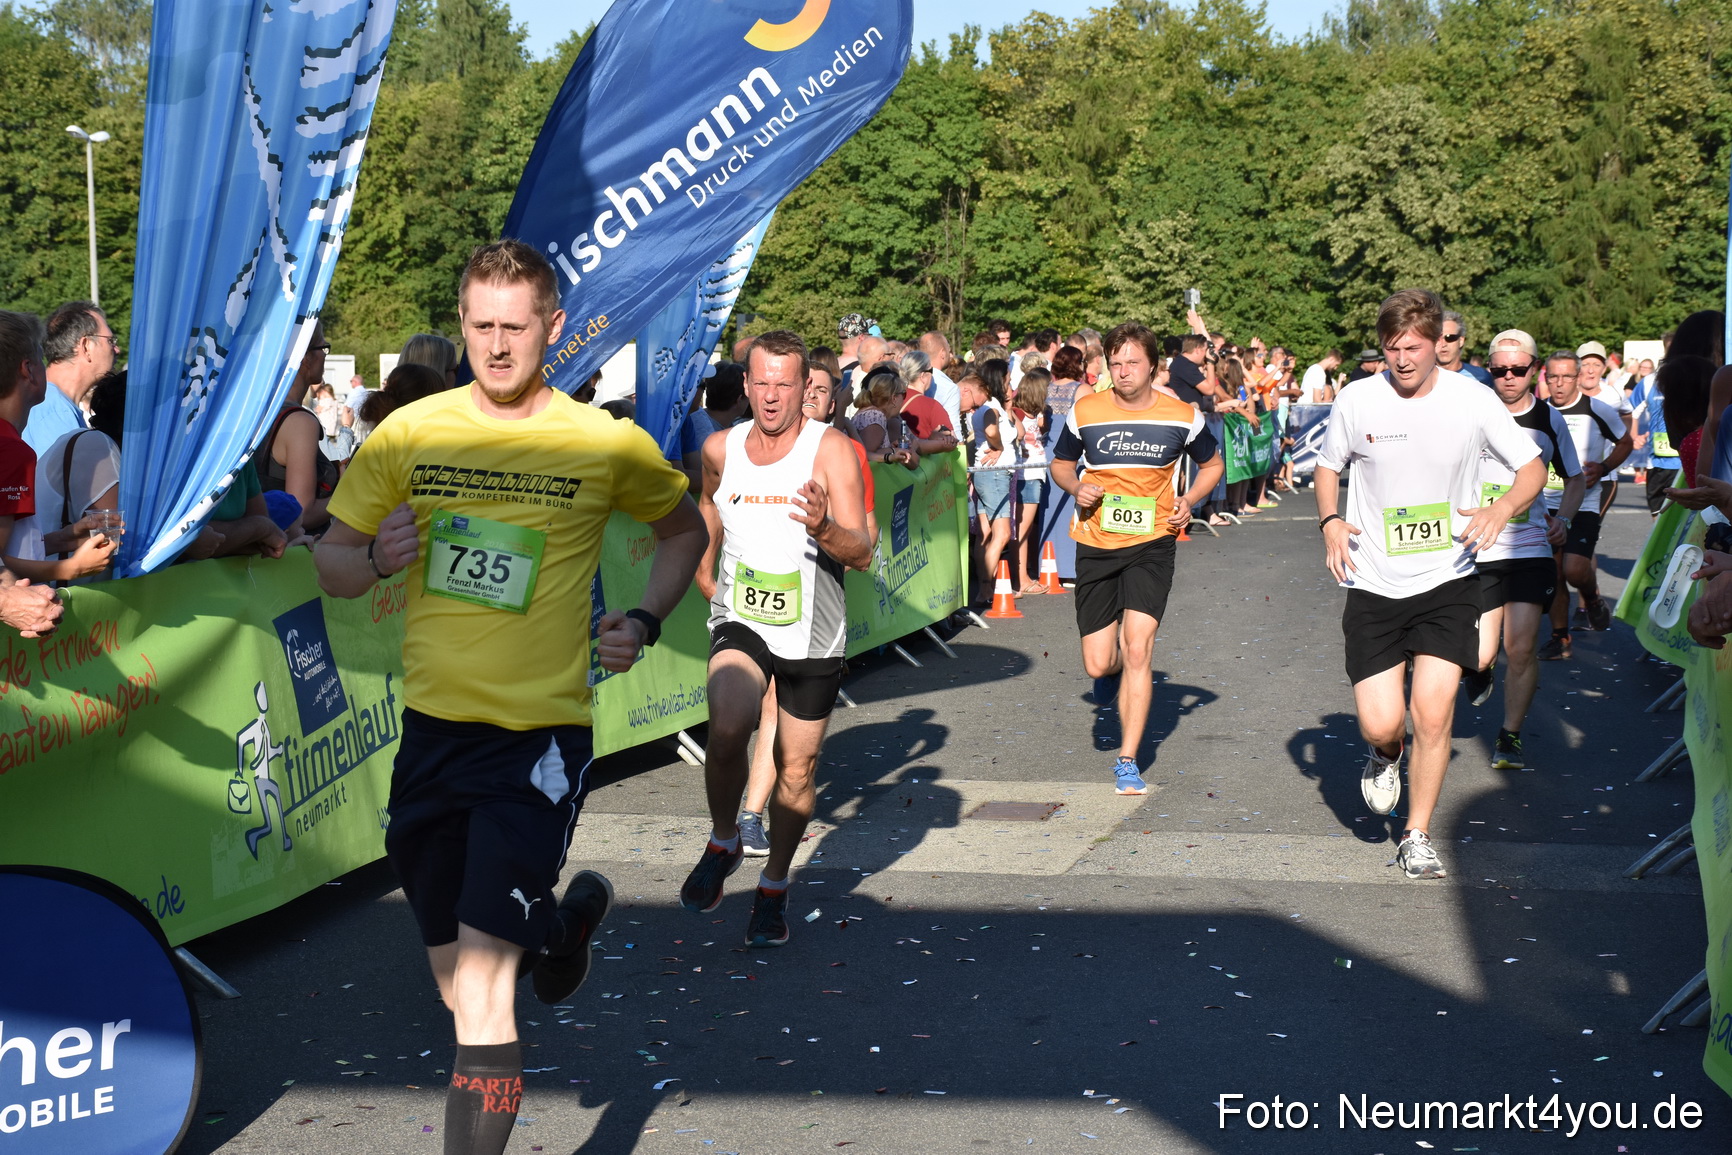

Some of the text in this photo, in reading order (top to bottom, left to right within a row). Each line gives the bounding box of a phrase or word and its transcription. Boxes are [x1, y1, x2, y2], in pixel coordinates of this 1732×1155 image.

[686, 25, 883, 209] Druck und Medien
[547, 66, 782, 288] ischmann
[541, 314, 610, 383] n-net.de
[1109, 440, 1167, 453] Fischer
[1114, 451, 1163, 459] AUTOMOBILE
[411, 464, 582, 499] grasenhiller
[461, 491, 573, 510] KOMPETENZ IM BÜRO
[744, 495, 793, 504] KLEBL
[1112, 508, 1143, 524] 603
[1394, 520, 1442, 542] 1791
[449, 544, 513, 584] 735
[446, 575, 505, 595] Frenzl Markus
[481, 592, 500, 600] GmbH
[745, 586, 786, 610] 875
[760, 608, 787, 616] Bernhard
[37, 619, 121, 681] Firmen
[293, 640, 324, 671] Fischer
[0, 652, 160, 775] aufen länger!
[284, 671, 399, 807] firmenlauf
[295, 781, 347, 838] neumarkt
